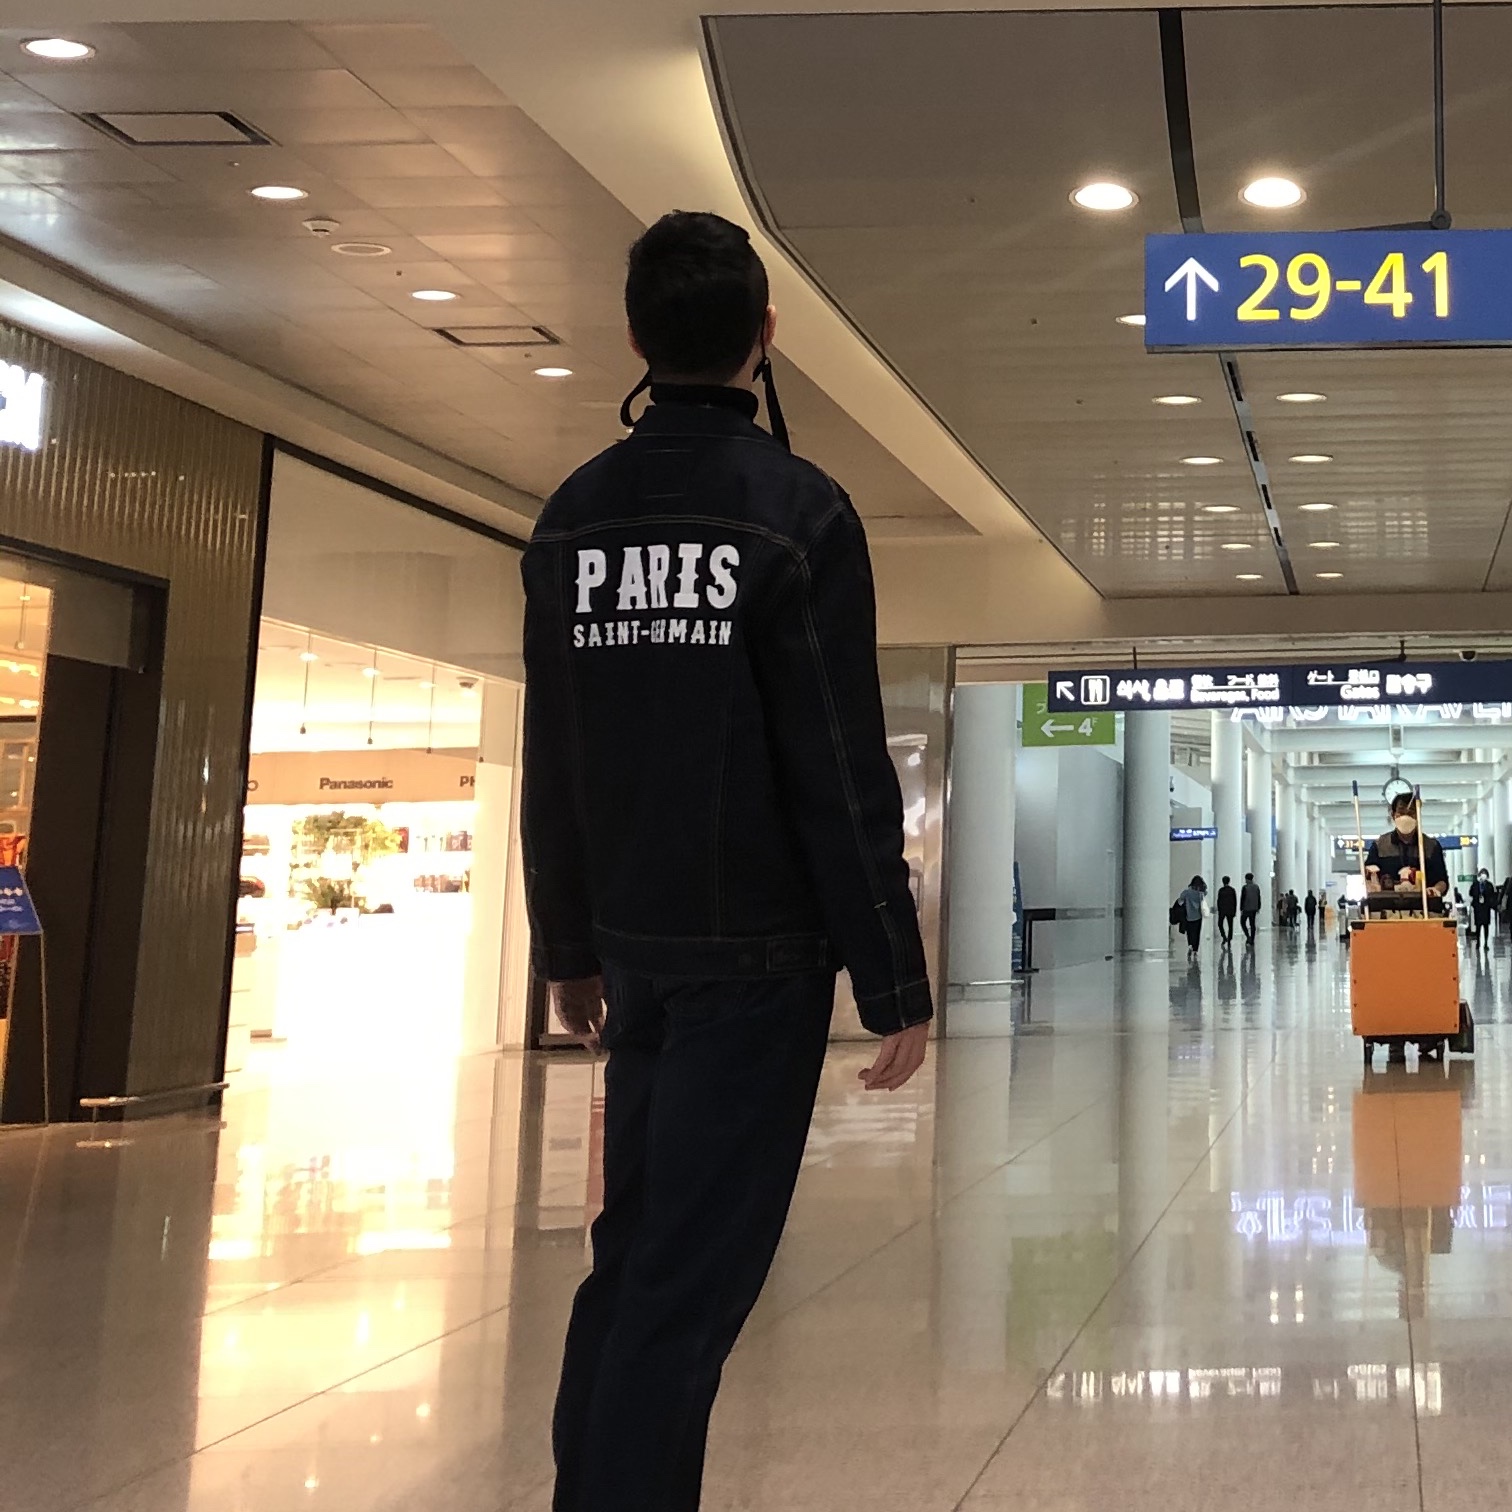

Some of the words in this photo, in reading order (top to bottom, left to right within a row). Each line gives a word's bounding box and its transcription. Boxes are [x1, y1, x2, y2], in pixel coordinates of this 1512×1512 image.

[1236, 250, 1450, 322] 29-41
[574, 542, 741, 614] PARIS
[318, 776, 394, 791] Panasonic
